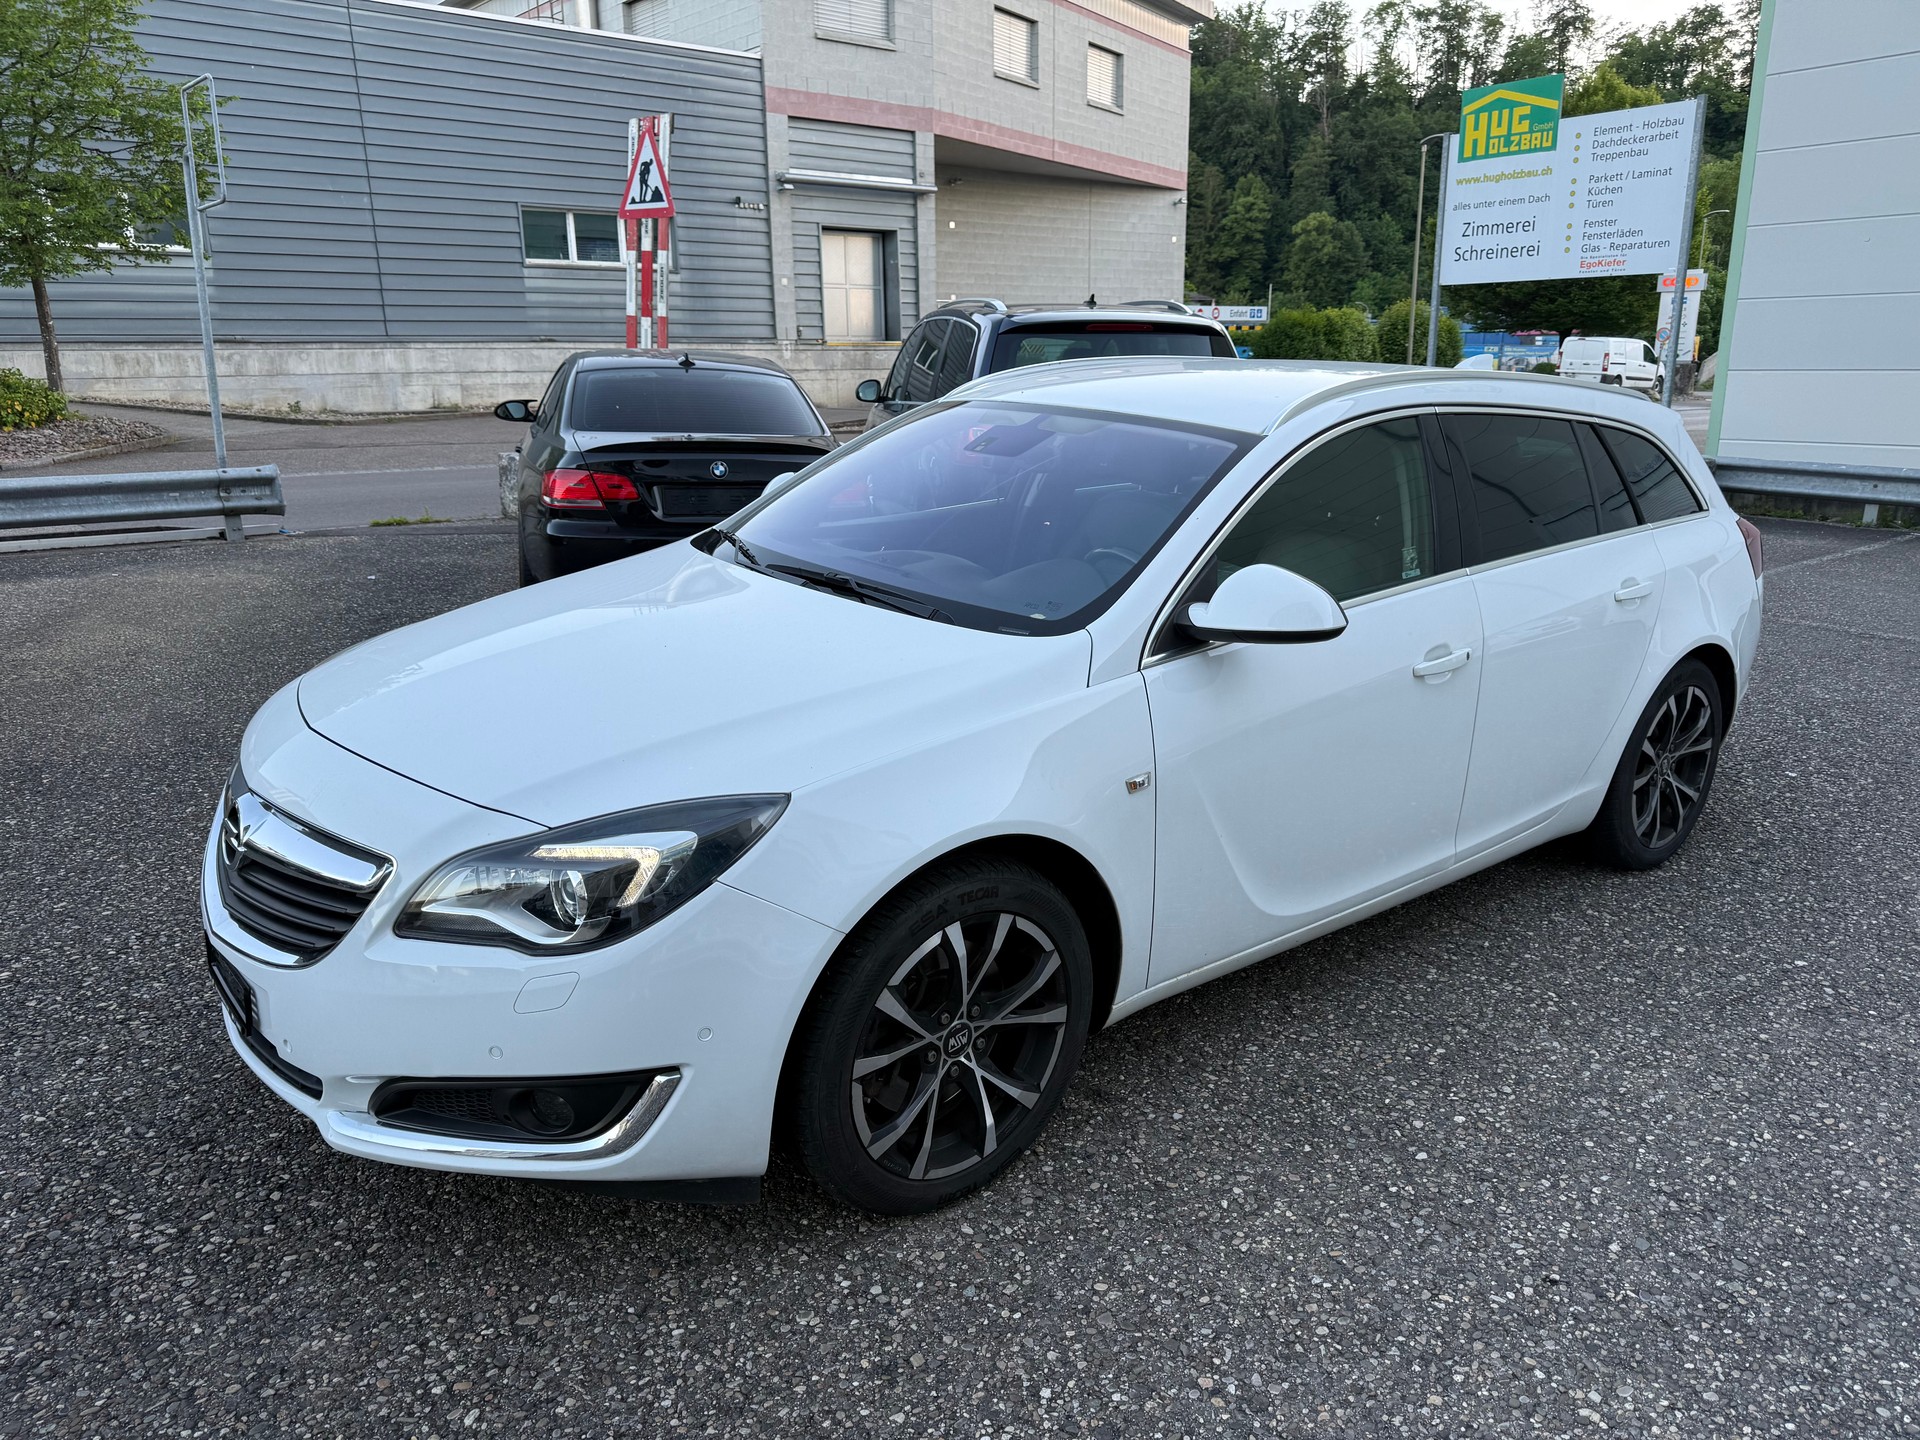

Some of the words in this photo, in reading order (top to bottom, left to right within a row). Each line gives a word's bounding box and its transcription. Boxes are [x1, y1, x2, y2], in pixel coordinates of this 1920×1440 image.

[1463, 105, 1531, 158] HUG
[1532, 121, 1554, 131] GmbH
[1593, 123, 1633, 137] Element
[1642, 117, 1685, 130] Holzbau
[1592, 130, 1679, 150] Dachdeckerarbeit
[1591, 148, 1649, 162] Treppenbau
[1456, 166, 1553, 186] www.hugholzbau.ch
[1588, 172, 1623, 184] Parkett
[1625, 171, 1630, 180] /
[1632, 166, 1672, 180] Laminat
[1587, 185, 1623, 196] Küchen
[1452, 202, 1471, 212] alles
[1473, 199, 1497, 209] unter
[1498, 197, 1526, 207] einem
[1528, 193, 1551, 204] Dach
[1586, 199, 1614, 209] Türen
[1461, 215, 1536, 237] Zimmerei
[1583, 219, 1618, 229] Fenster
[1582, 228, 1643, 241] Fensterläden
[1454, 240, 1541, 262] Schreinerei
[1581, 243, 1601, 253] Glas
[1609, 240, 1671, 252] Reparaturen
[1580, 259, 1627, 270] EgoKiefer
[948, 1029, 968, 1053] MSW
